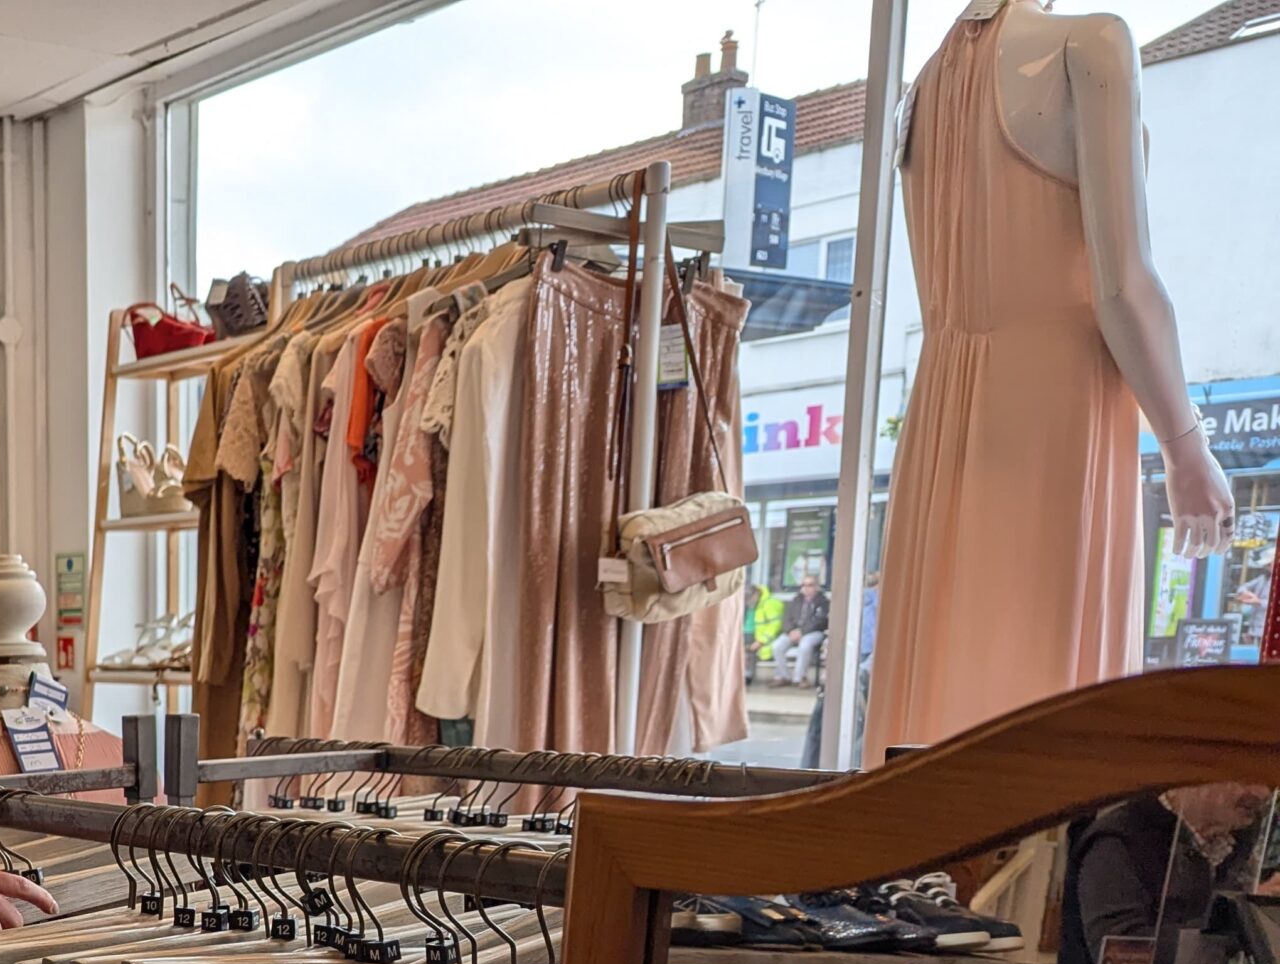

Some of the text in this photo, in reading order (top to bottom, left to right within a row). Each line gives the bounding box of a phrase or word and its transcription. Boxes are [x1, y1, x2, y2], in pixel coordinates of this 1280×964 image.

[775, 104, 788, 118] Stop
[736, 110, 753, 160] travel
[742, 404, 844, 455] ink
[145, 901, 157, 911] 10
[314, 893, 328, 908] M
[178, 913, 190, 925] 12
[204, 917, 217, 929] 12
[237, 916, 250, 928] 12
[276, 924, 290, 936] 12
[316, 930, 328, 943] 12
[334, 932, 345, 946] M
[348, 943, 358, 956] M
[369, 948, 381, 961] M
[387, 944, 398, 958] M
[430, 949, 441, 962] M
[448, 946, 457, 960] M
